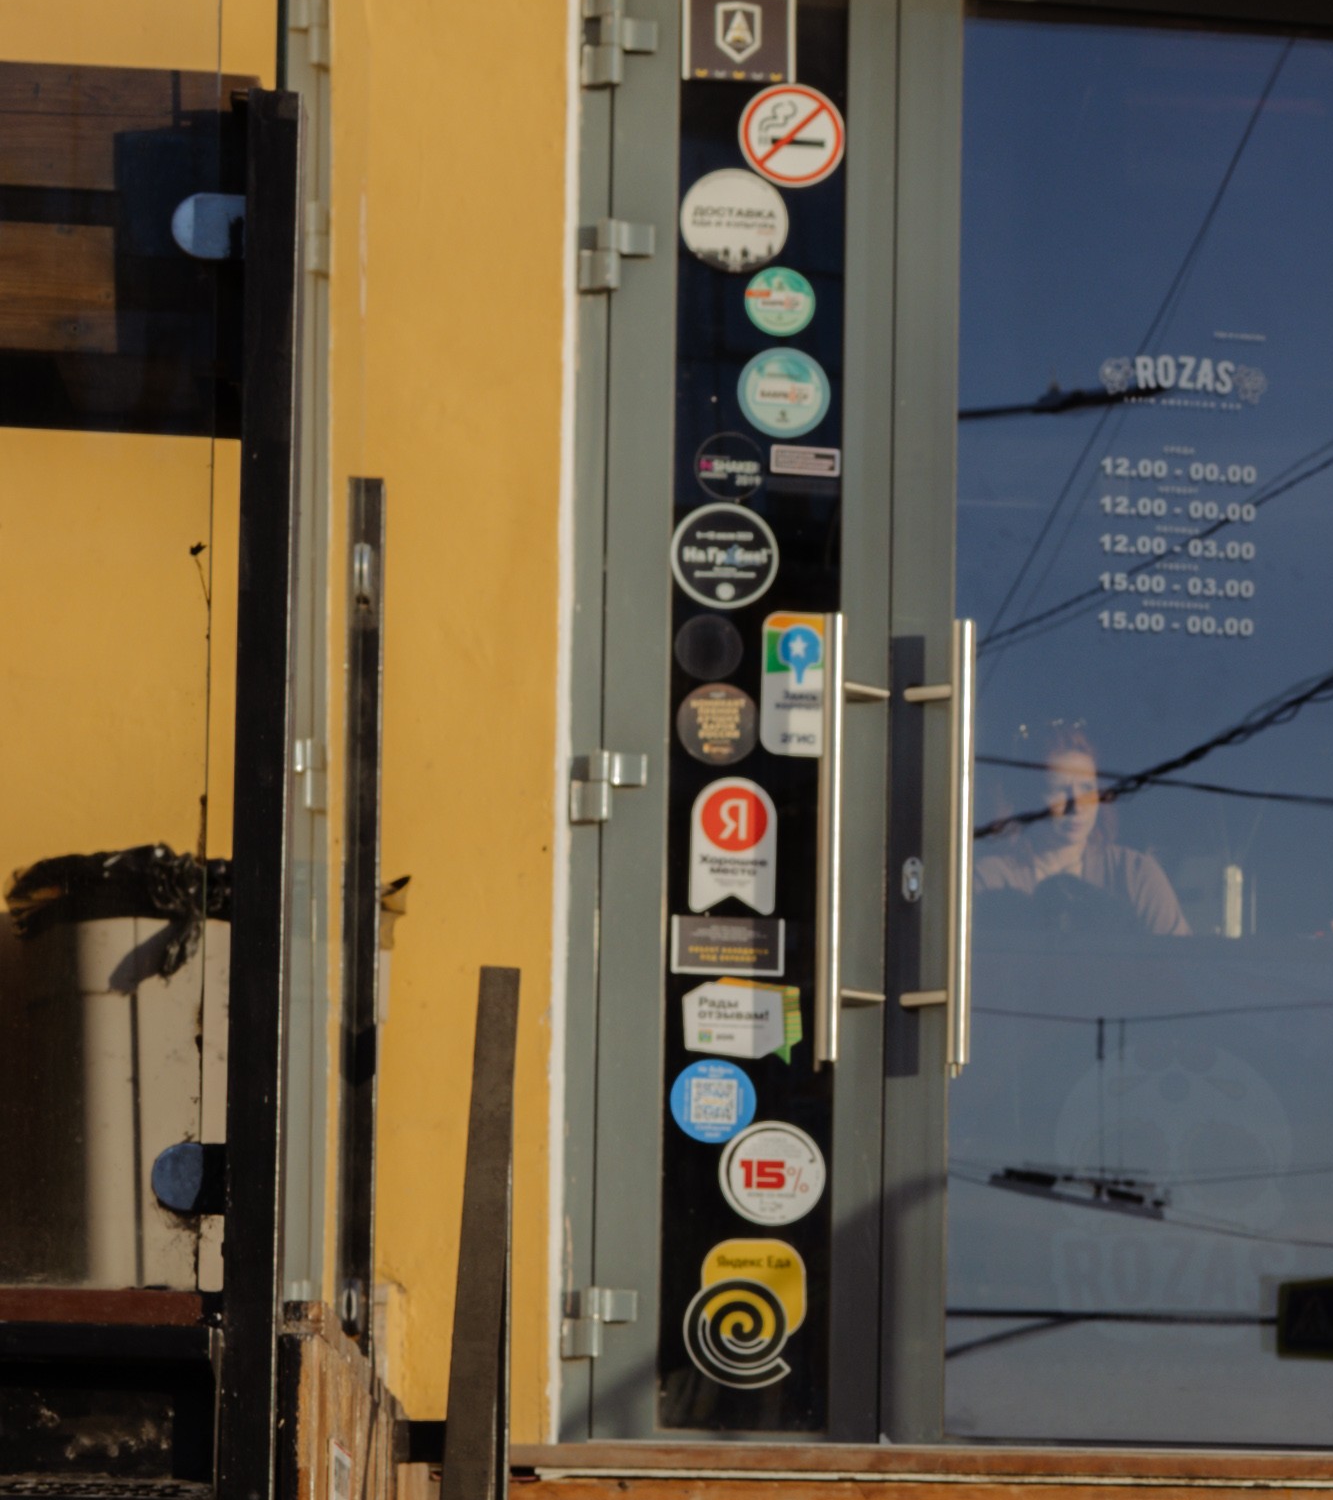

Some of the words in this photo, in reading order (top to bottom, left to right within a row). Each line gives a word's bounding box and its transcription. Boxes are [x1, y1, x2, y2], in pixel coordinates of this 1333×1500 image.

[1135, 354, 1236, 395] ROZAS
[1101, 456, 1168, 478] 12.00
[1189, 462, 1257, 484] 00.00
[1100, 495, 1167, 516] 12.00
[1189, 501, 1256, 522] 00.00
[1099, 533, 1166, 555] 12.00
[1188, 538, 1255, 560] 03.00
[1099, 571, 1166, 593] 15.00
[1187, 576, 1255, 598] 03.00
[1098, 610, 1165, 632] 15.00
[1187, 614, 1254, 636] 00.00
[719, 798, 748, 841] Я
[699, 854, 768, 867] Хорошее
[698, 996, 739, 1010] Рады
[698, 1010, 770, 1022] отзывам!
[739, 1159, 810, 1193] 15%
[716, 1256, 763, 1269] Яндекс
[767, 1256, 792, 1268] Еда
